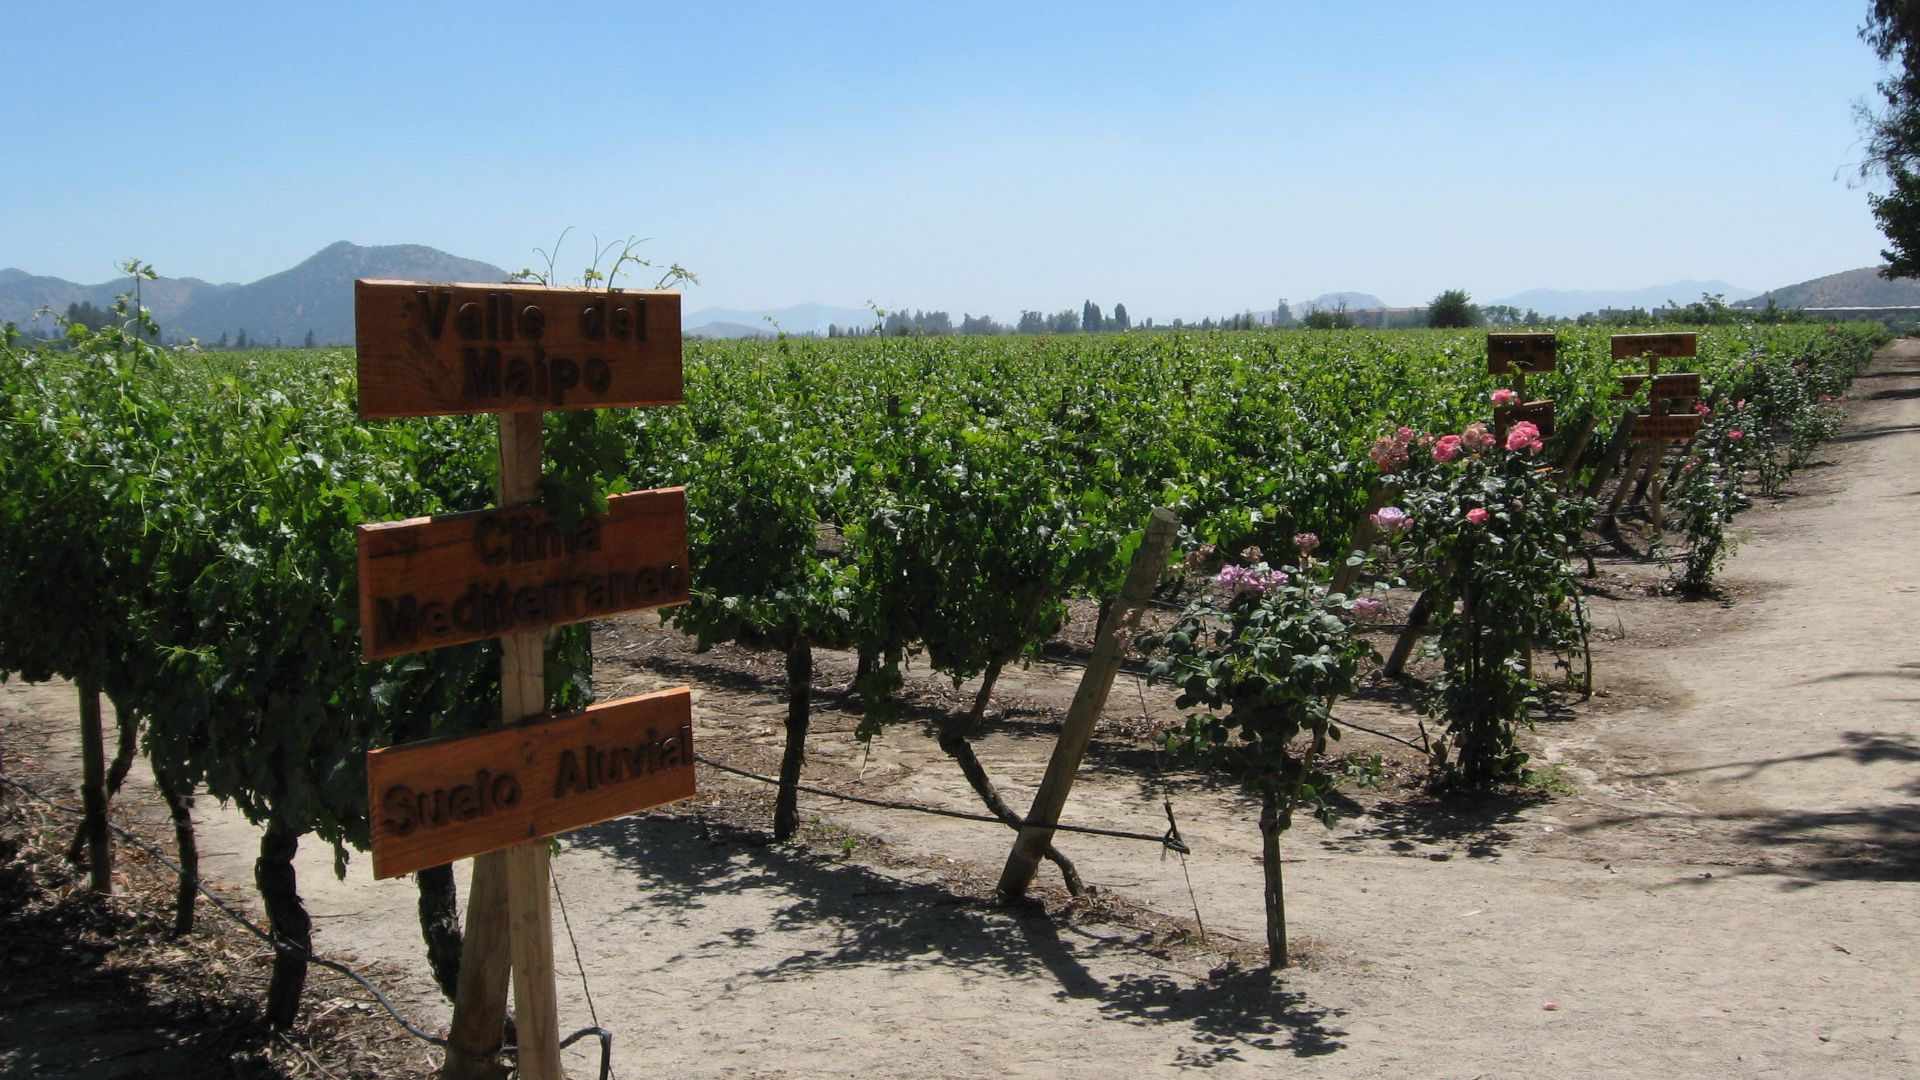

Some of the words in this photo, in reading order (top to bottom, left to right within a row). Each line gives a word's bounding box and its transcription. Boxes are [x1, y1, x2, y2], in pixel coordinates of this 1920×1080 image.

[416, 290, 546, 341] Valle
[580, 296, 647, 342] del
[463, 346, 612, 405] Maipo
[475, 514, 601, 566] Clima
[375, 564, 688, 646] Mediterraneo
[382, 768, 522, 836] Suelo
[553, 724, 691, 799] Aluvial
